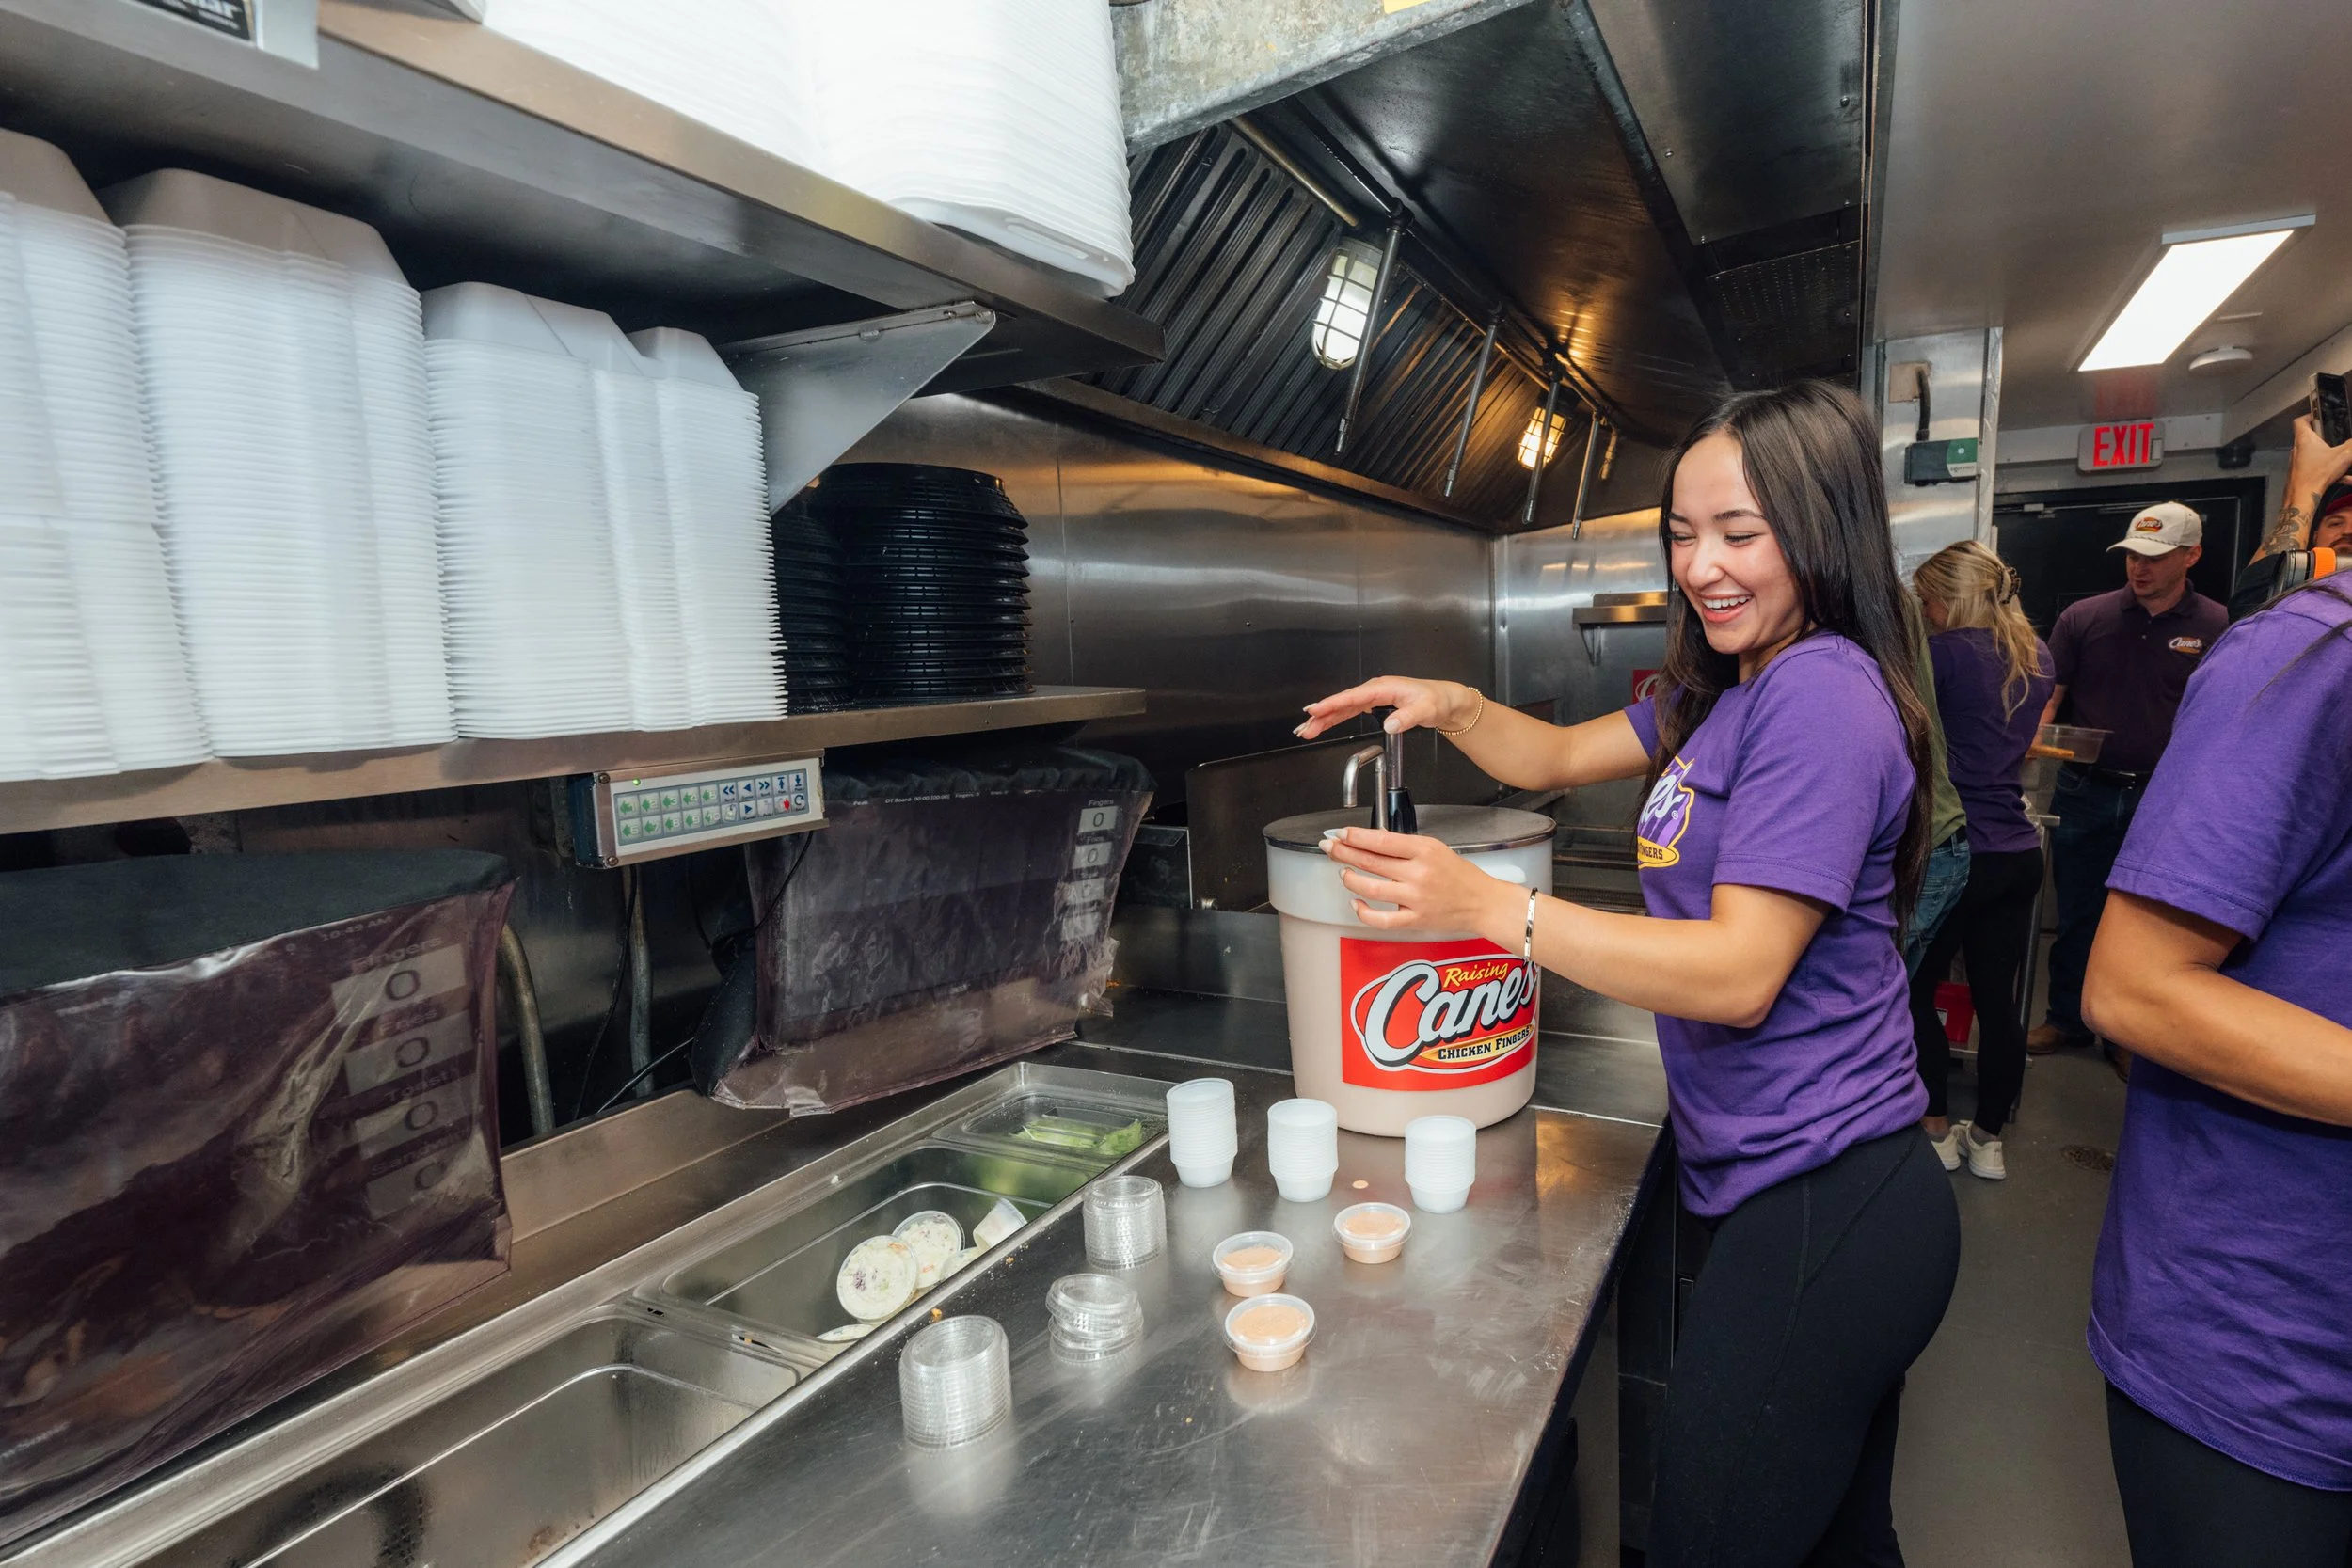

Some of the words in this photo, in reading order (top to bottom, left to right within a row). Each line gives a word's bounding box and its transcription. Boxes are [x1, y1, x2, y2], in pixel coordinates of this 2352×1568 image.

[2092, 422, 2154, 467] EXIT
[2169, 637, 2202, 649] Cane's
[1092, 812, 1104, 827] 0
[351, 937, 442, 972] Fingers
[385, 969, 421, 1001] 0
[1443, 961, 1509, 988] Raising
[1364, 959, 1537, 1063] Cane's
[394, 1037, 430, 1069] 0
[385, 1069, 451, 1103] Toast
[405, 1101, 438, 1132] 0
